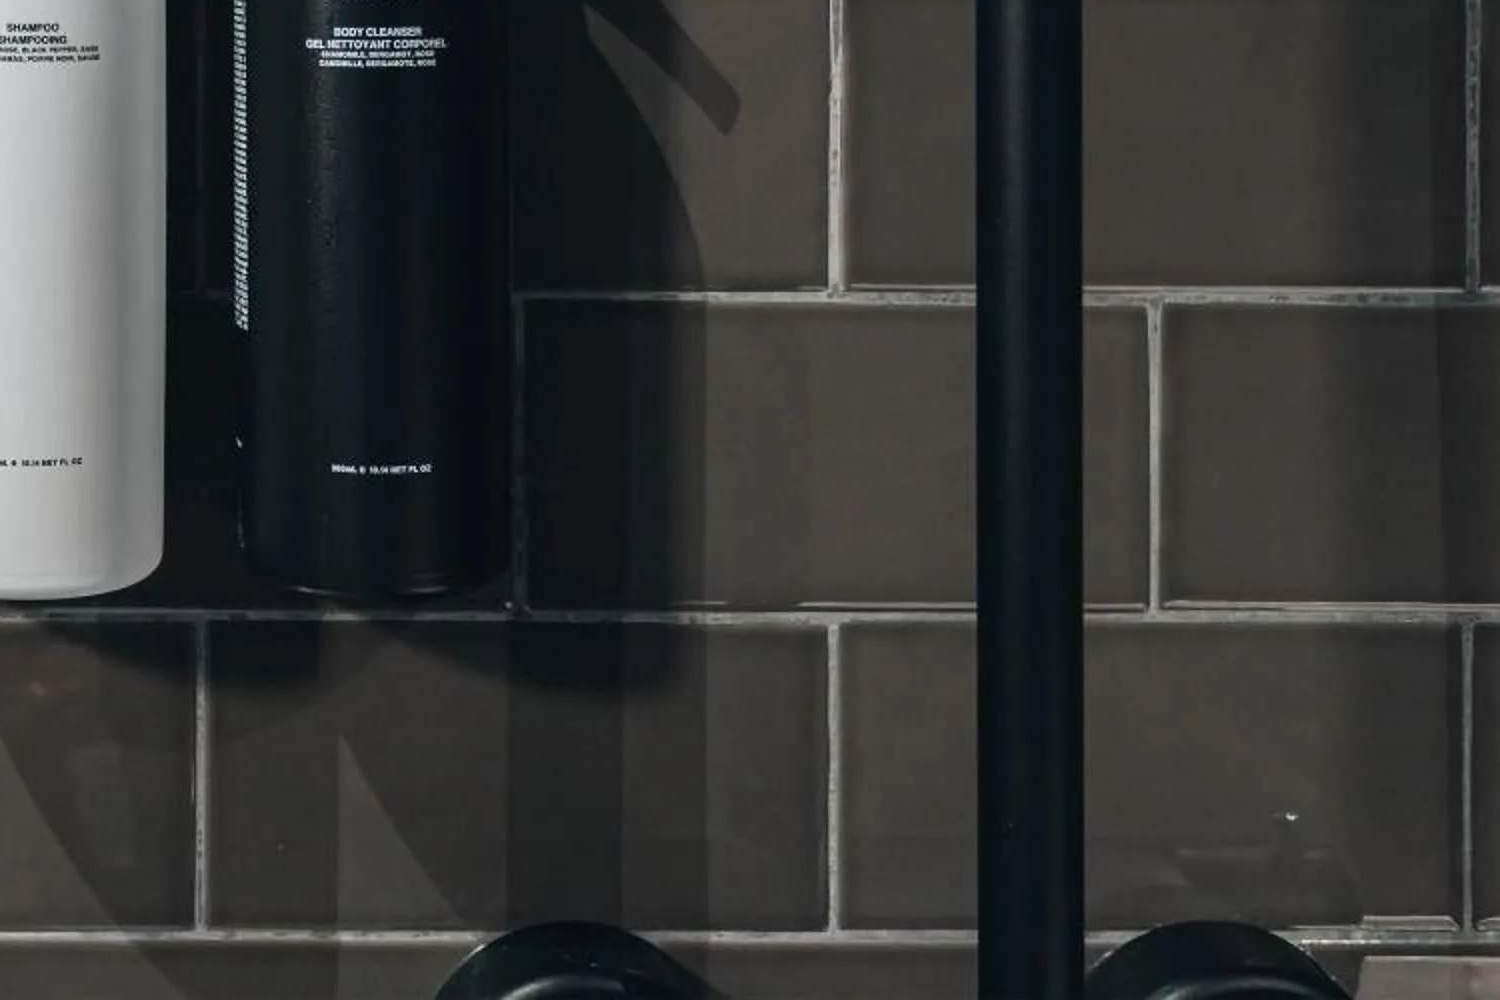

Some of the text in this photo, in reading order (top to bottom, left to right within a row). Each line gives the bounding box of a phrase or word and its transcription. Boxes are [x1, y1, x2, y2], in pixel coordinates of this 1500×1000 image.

[6, 23, 60, 32] SHAMPOO
[333, 26, 423, 37] BODY CLEANSER
[305, 39, 325, 49] GEL
[327, 39, 392, 49] NETTOYANT
